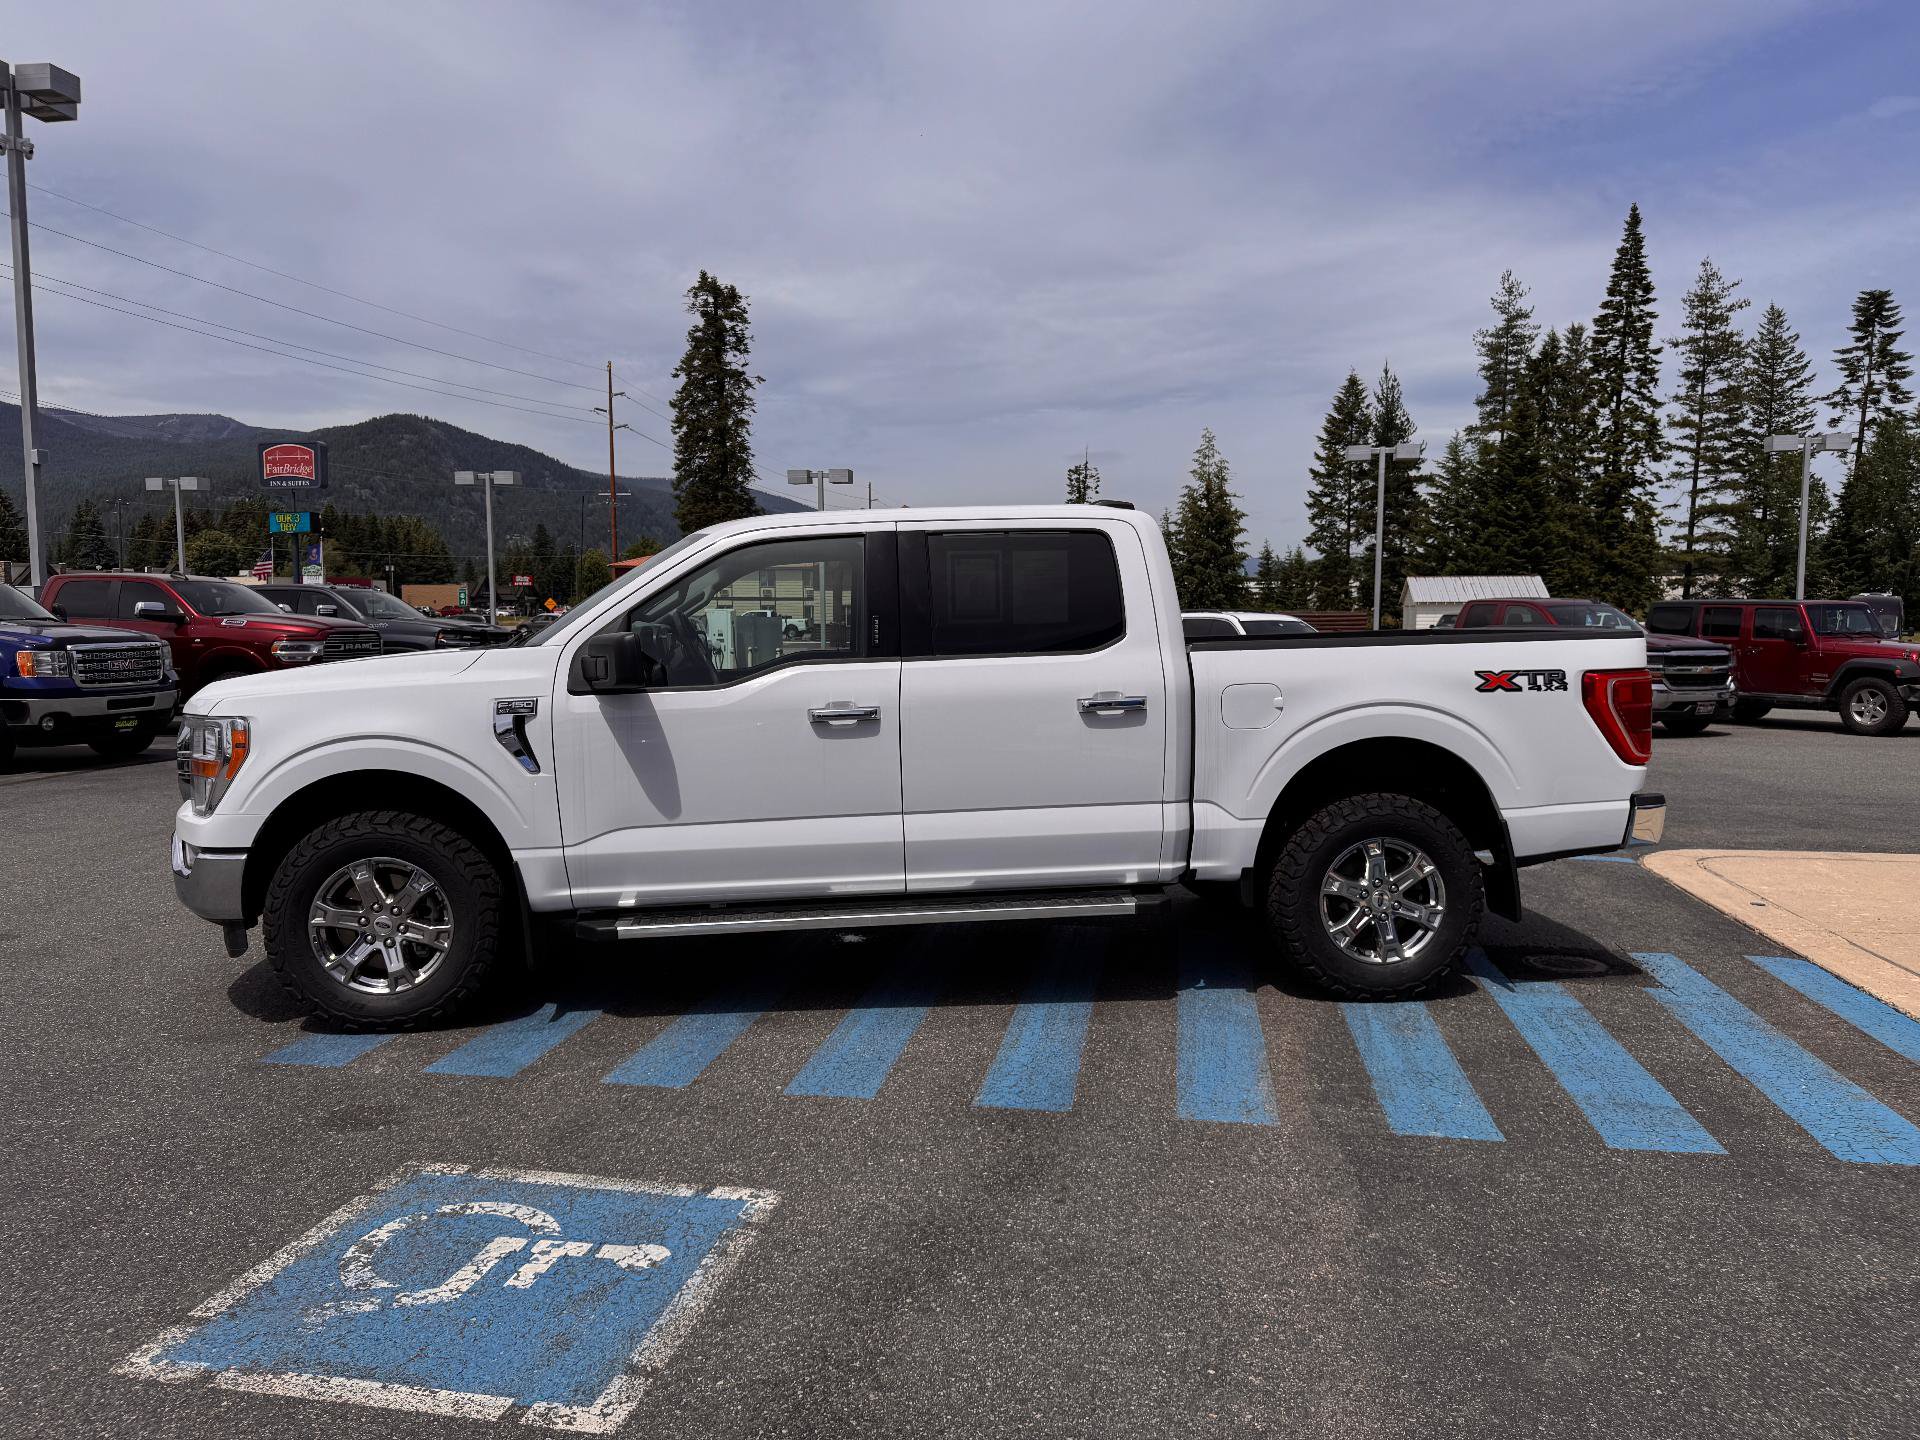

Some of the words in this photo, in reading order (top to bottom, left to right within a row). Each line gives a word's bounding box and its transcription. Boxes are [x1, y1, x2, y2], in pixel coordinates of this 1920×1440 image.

[266, 463, 313, 476] FairBridge
[276, 514, 292, 522] OUR
[294, 514, 300, 522] 3
[281, 523, 297, 531] DAY
[109, 659, 144, 670] GMC
[1474, 669, 1568, 693] XTR
[498, 701, 533, 709] F-150
